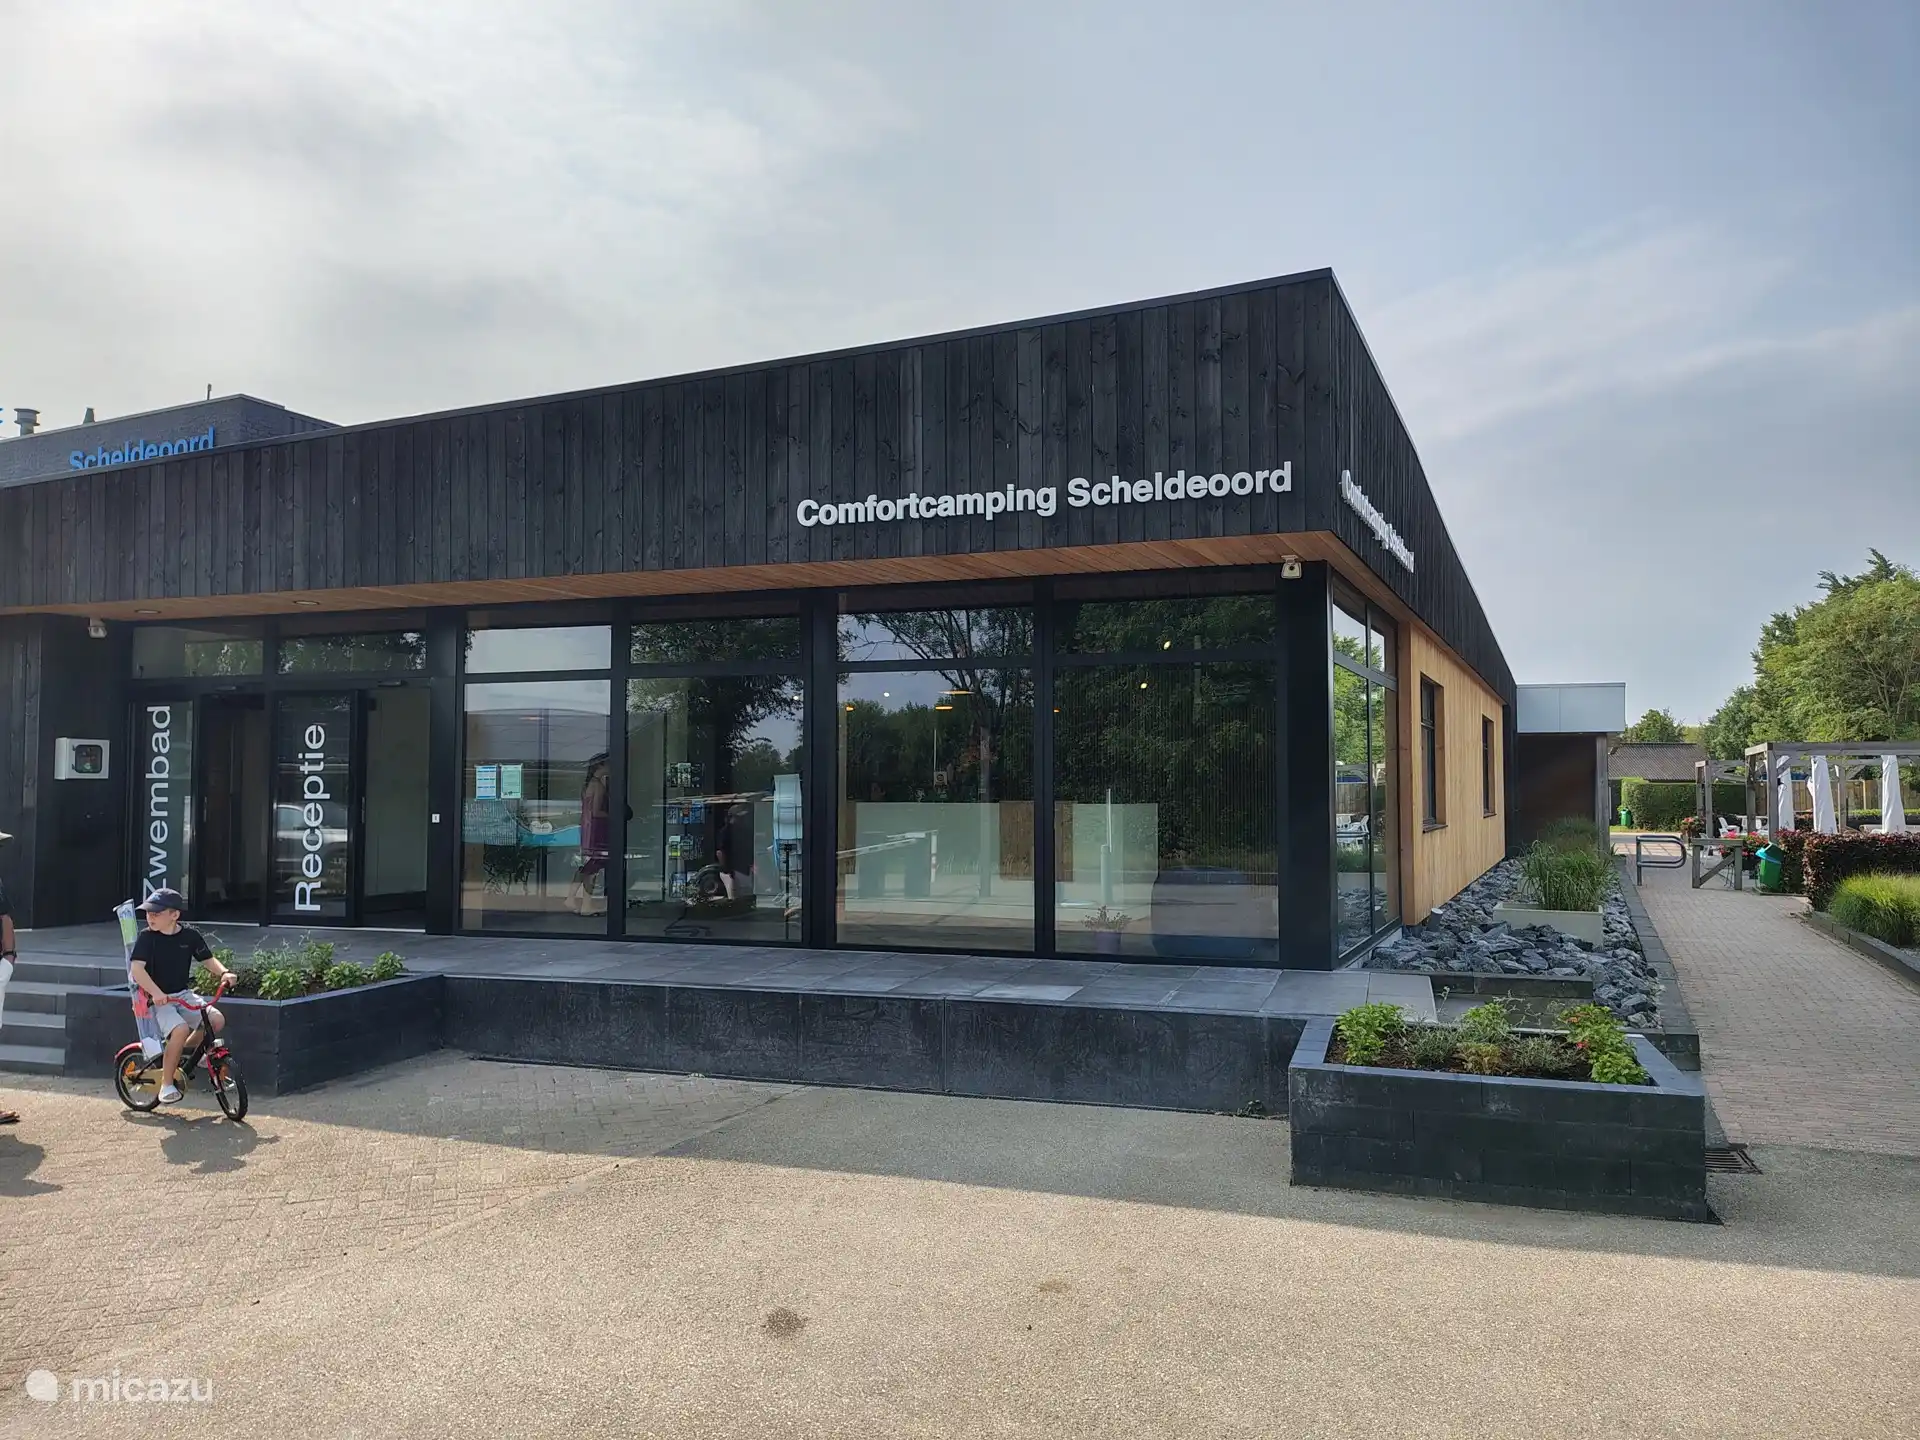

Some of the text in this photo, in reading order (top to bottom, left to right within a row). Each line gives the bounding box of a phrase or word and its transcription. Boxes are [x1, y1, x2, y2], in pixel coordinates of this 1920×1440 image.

[797, 461, 1292, 526] Comfortcamping Scheldeoord
[294, 724, 331, 911] Receptie
